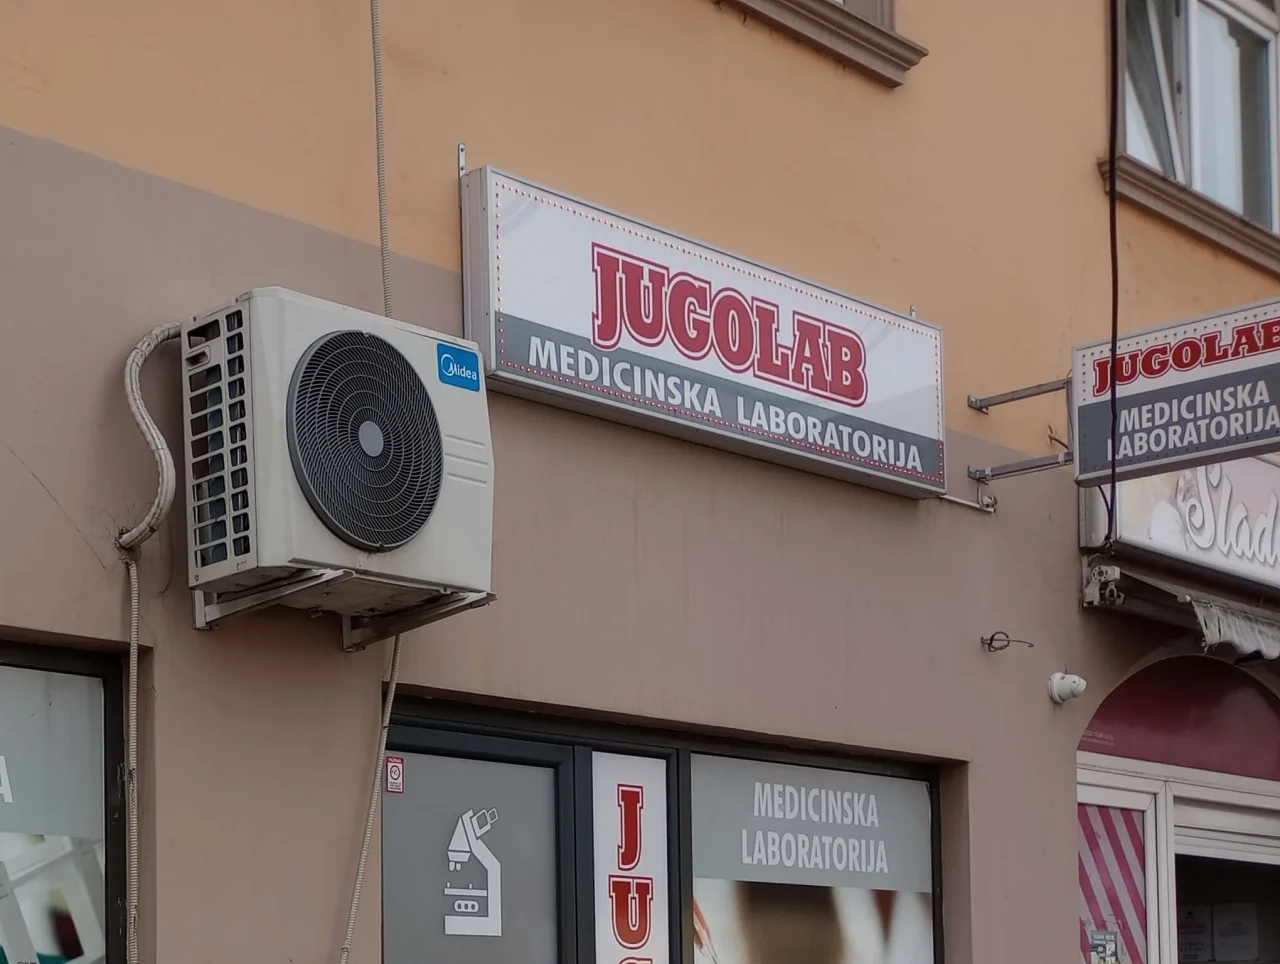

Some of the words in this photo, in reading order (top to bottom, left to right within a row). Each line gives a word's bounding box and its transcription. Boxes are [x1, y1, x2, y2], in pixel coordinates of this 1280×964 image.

[591, 242, 867, 408] JUGOLAB
[440, 353, 477, 380] Midea
[528, 336, 722, 418] MEDICINSKA
[737, 396, 923, 473] LABORATORIJA
[1119, 380, 1270, 433] MEDICINSKA
[1186, 465, 1280, 567] Slad
[753, 782, 880, 828] MEDICINSKA
[741, 829, 889, 874] LABORATORIJA
